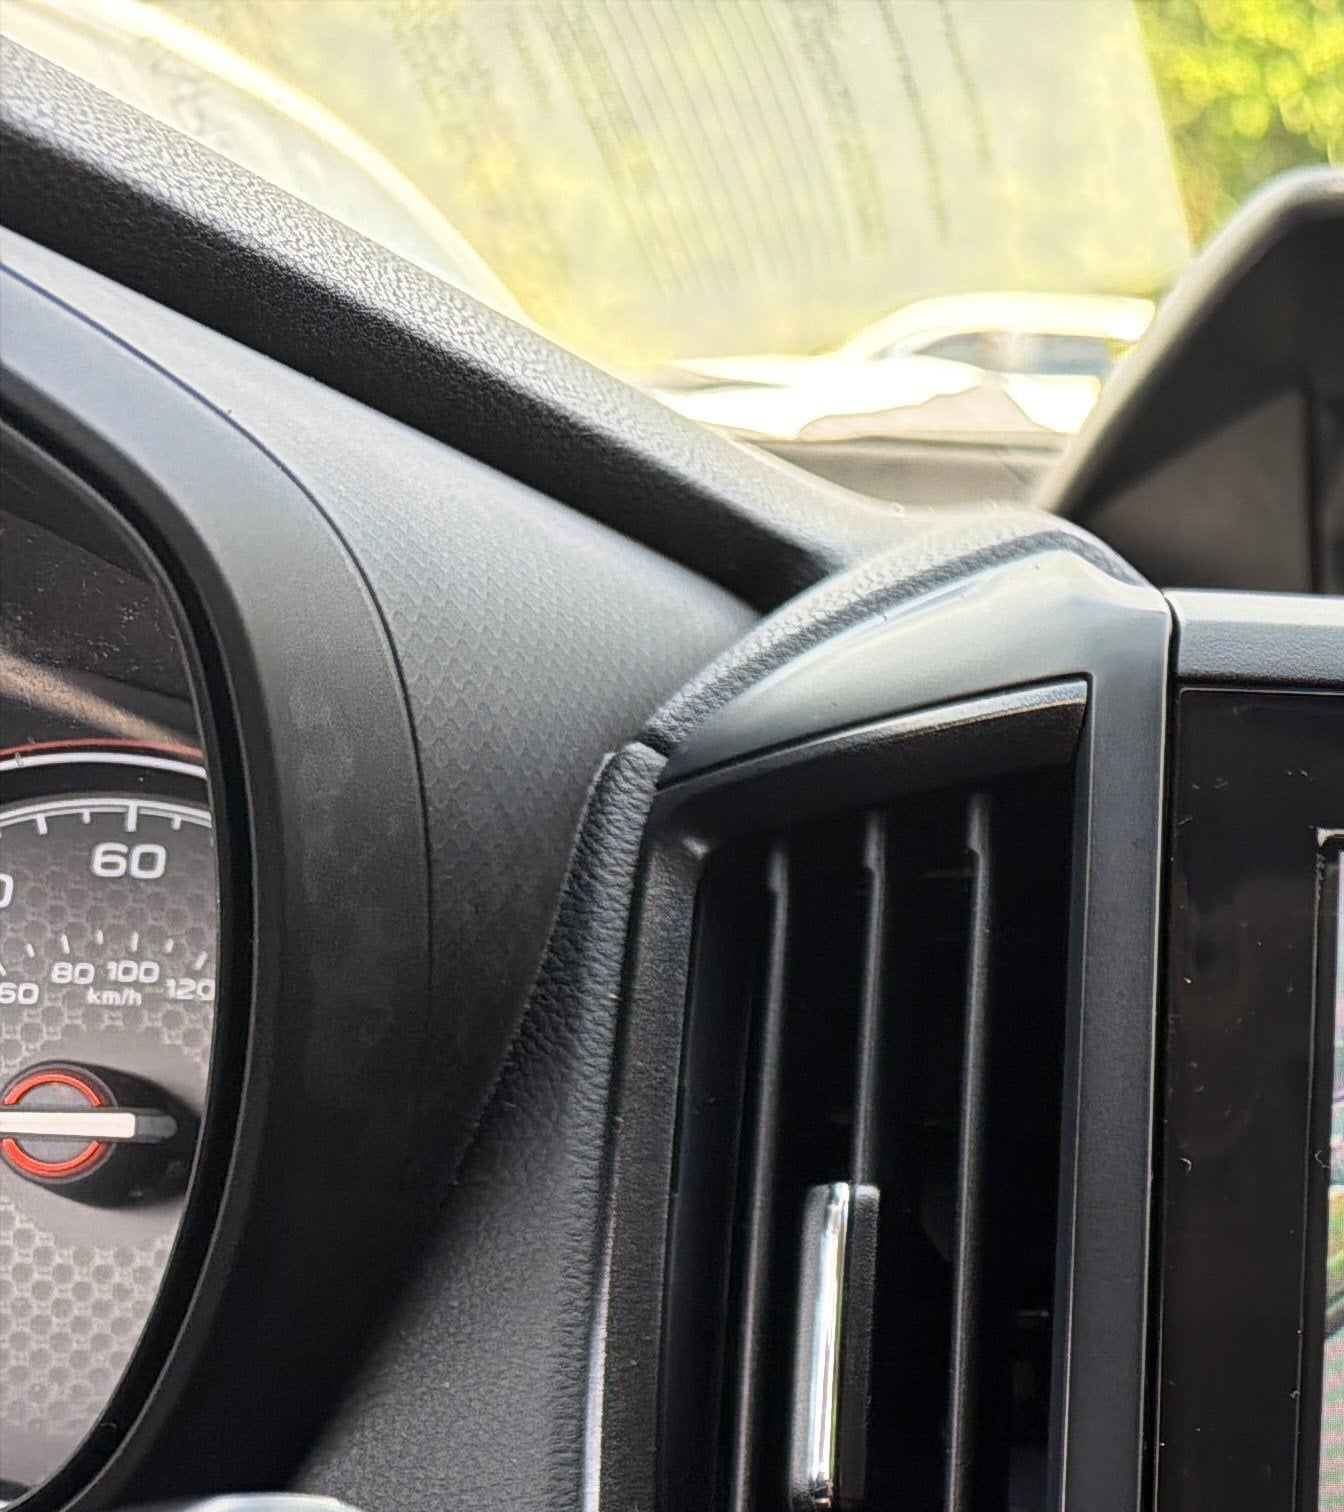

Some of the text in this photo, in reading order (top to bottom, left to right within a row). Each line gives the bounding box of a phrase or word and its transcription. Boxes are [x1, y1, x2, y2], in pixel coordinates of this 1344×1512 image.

[92, 842, 167, 879] 60
[51, 959, 160, 985] 80 100
[87, 986, 142, 1006] km/h
